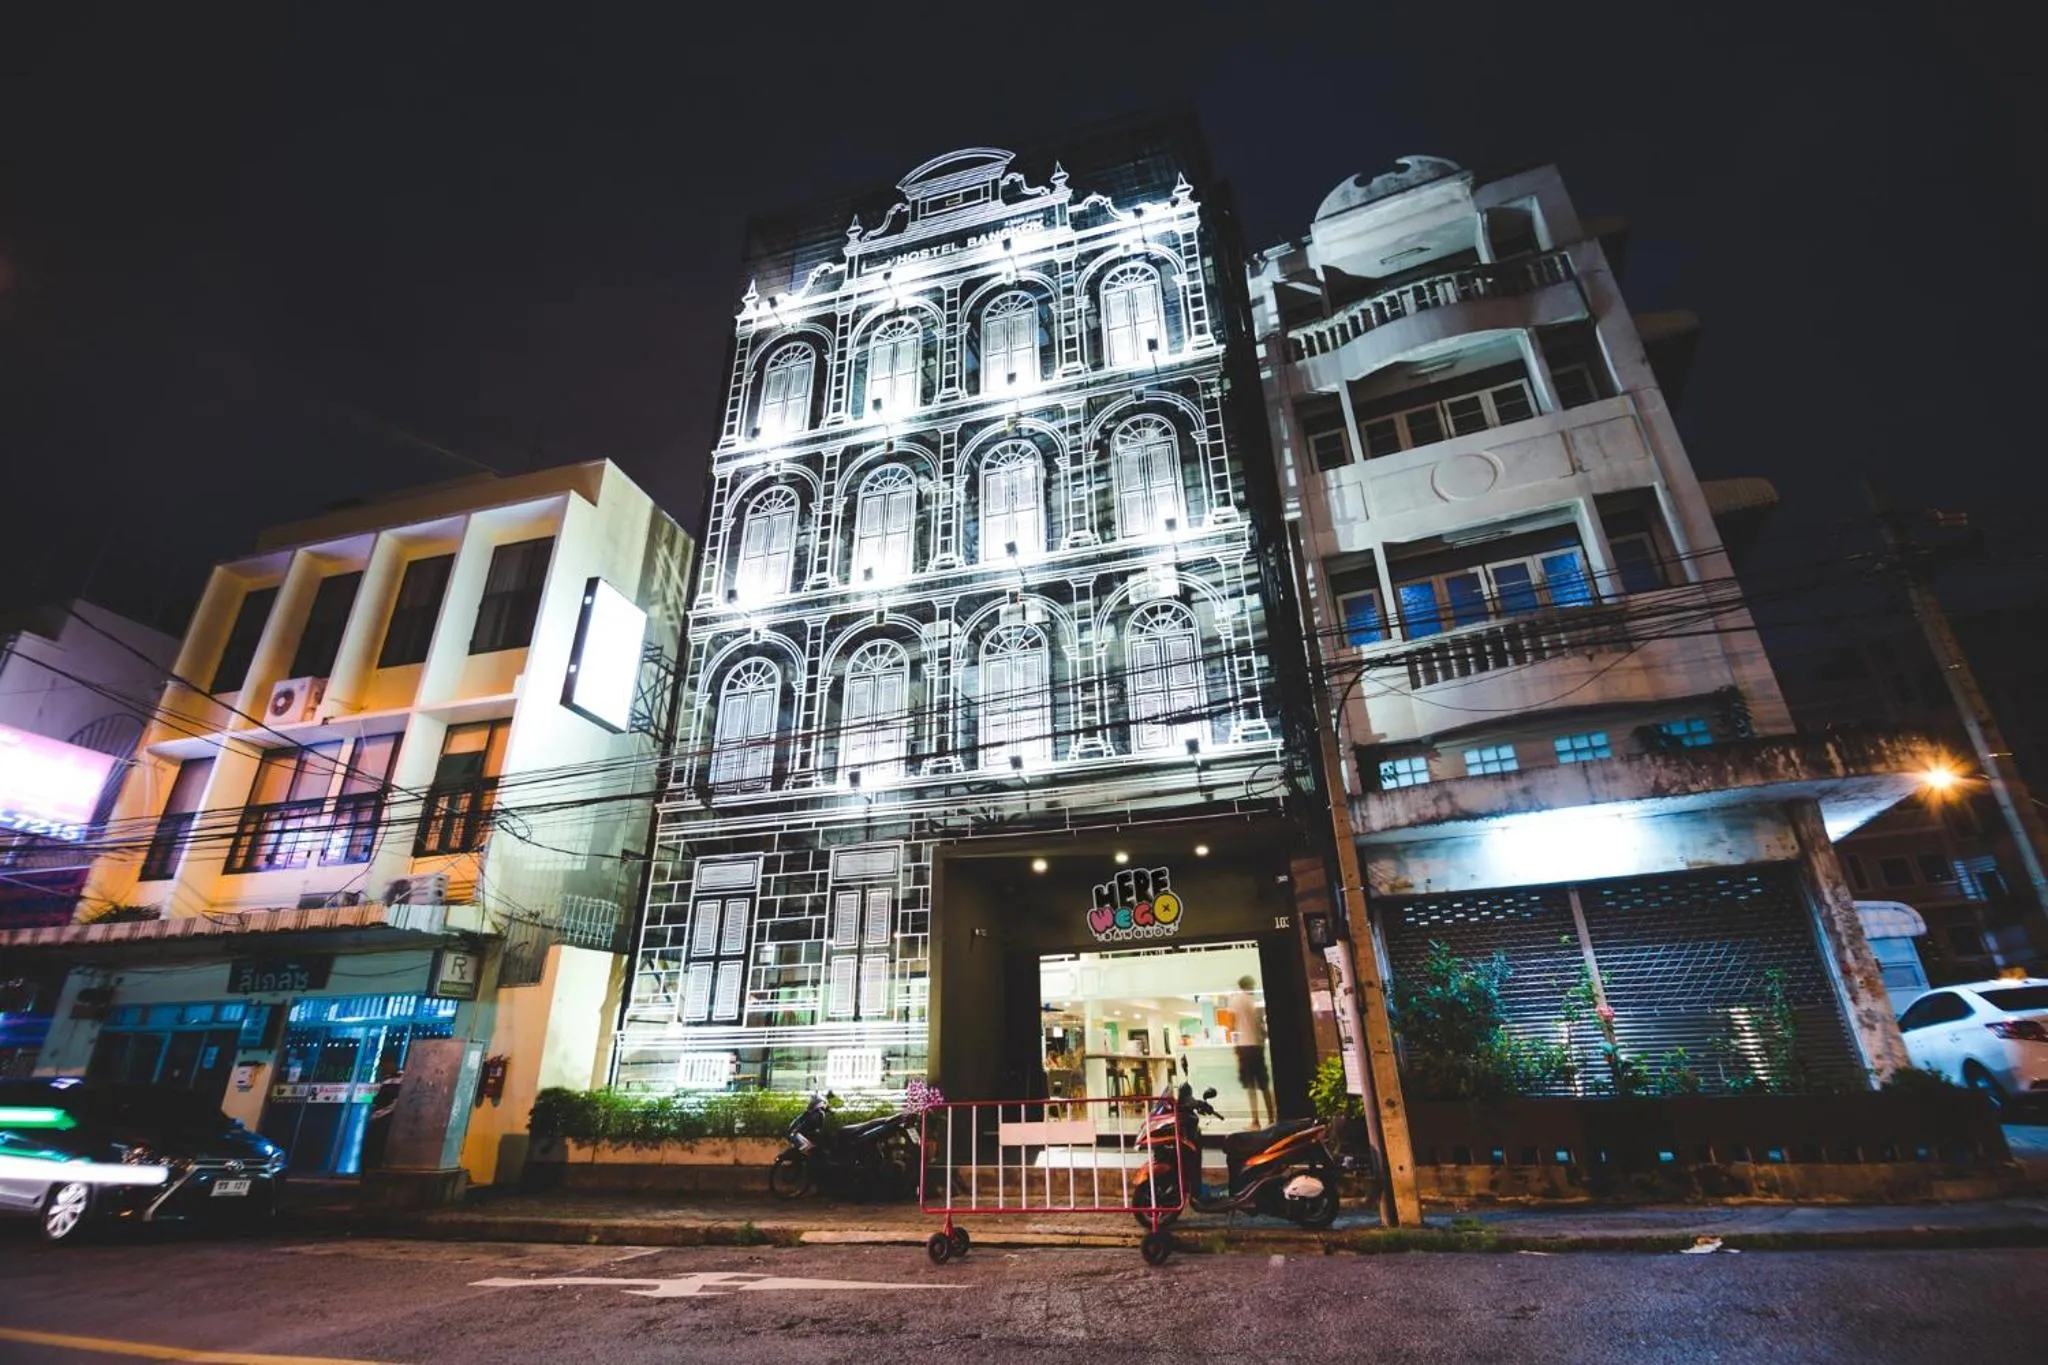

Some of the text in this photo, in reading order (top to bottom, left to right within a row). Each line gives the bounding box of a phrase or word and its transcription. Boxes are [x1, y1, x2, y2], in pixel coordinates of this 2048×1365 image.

[895, 243, 960, 264] HOSTEL
[967, 219, 1044, 247] BANGKOK
[1092, 867, 1170, 909] HERE
